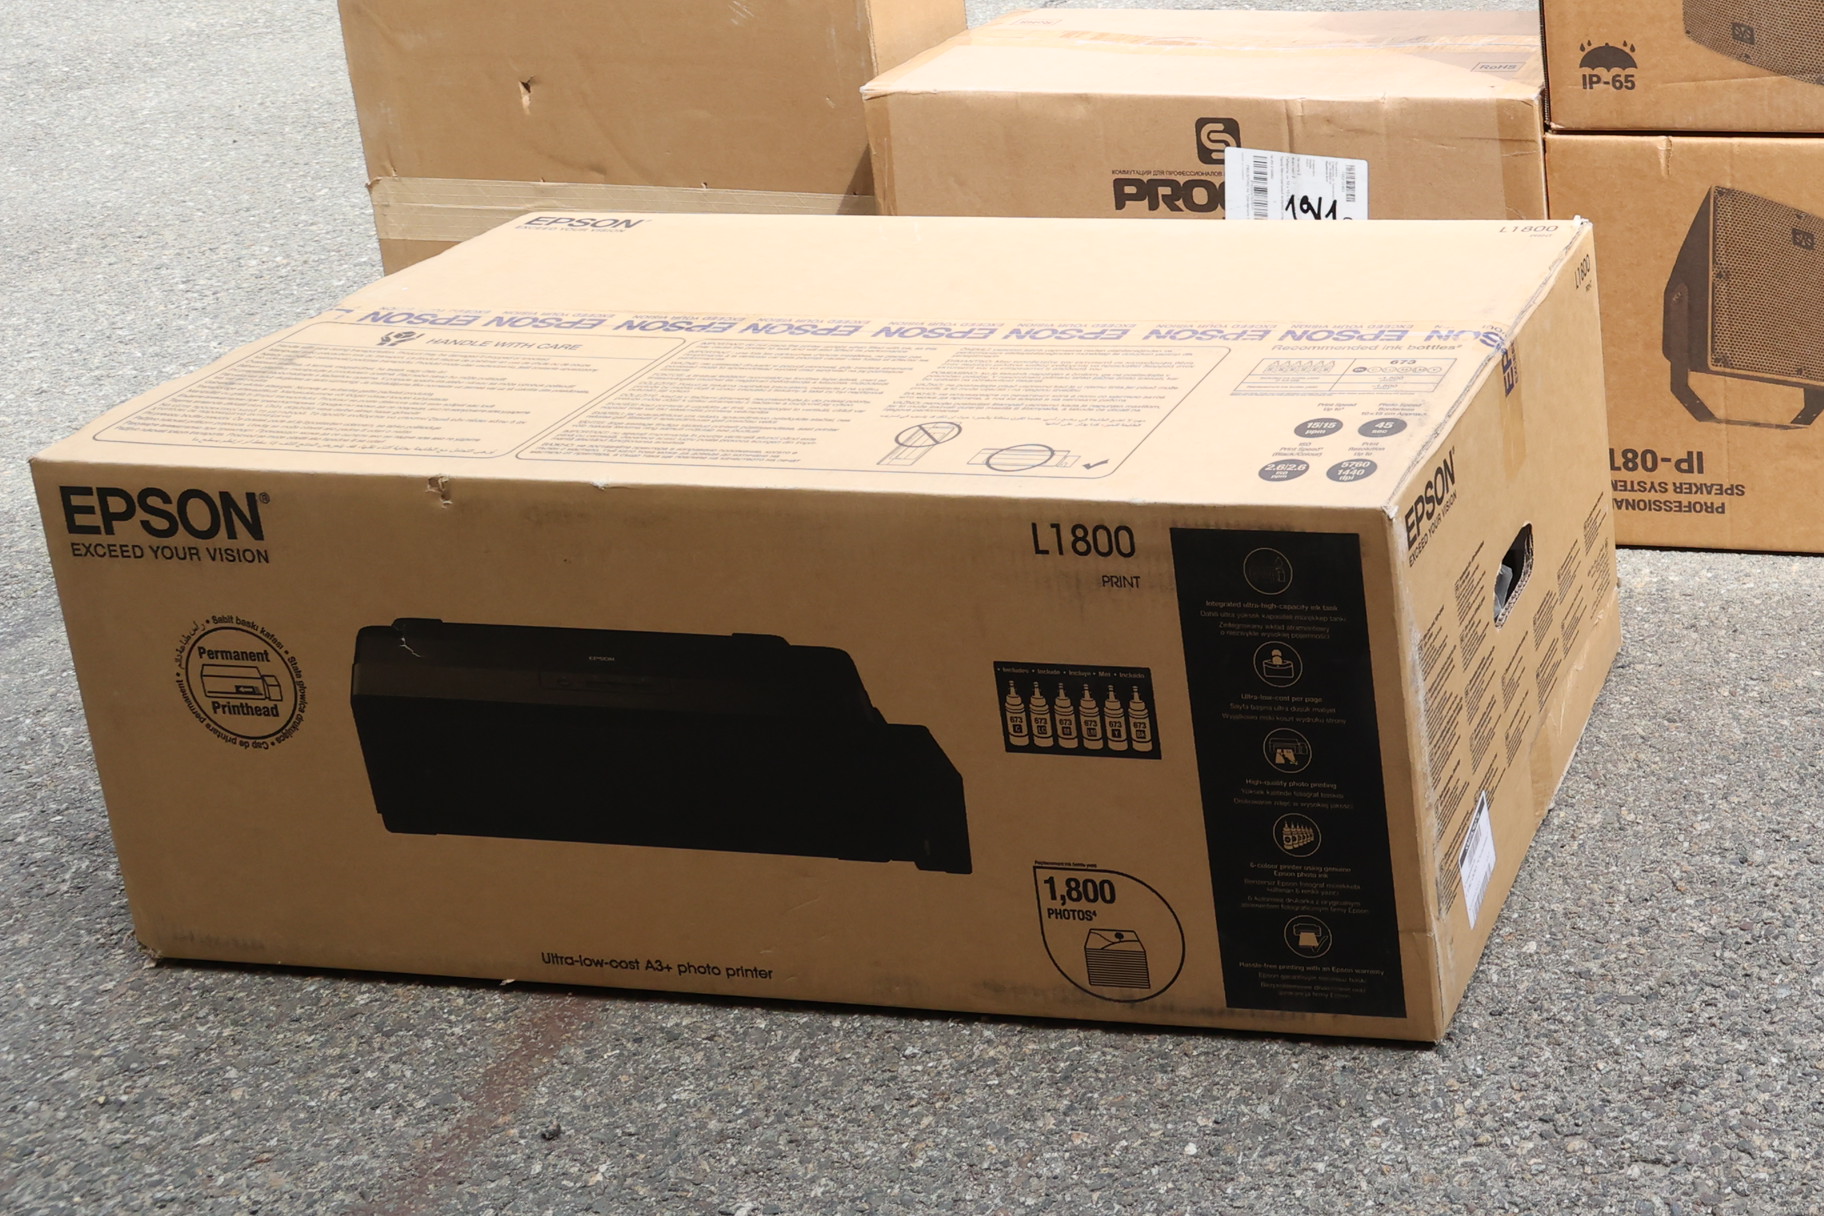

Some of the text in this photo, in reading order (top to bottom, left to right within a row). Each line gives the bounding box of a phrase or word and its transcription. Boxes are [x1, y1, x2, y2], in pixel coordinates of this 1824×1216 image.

[1582, 73, 1636, 92] IP-65
[1113, 178, 1225, 213] PRO
[524, 216, 645, 228] EPSON
[1499, 225, 1559, 233] L1800
[357, 311, 482, 326] EPSON
[482, 315, 607, 330] EPSON
[613, 319, 738, 333] EPSON
[738, 323, 864, 336] EPSON
[871, 326, 997, 340] EPSON
[1002, 327, 1130, 341] EPSON
[1142, 329, 1272, 342] EPSON
[1278, 329, 1408, 342] EPSON
[426, 338, 583, 351] HANDLE WITH CARE
[1306, 422, 1337, 430] 15/15
[1375, 422, 1394, 430] 45
[1338, 468, 1365, 476] 1440
[1672, 482, 1745, 496] SPEAKER
[1405, 450, 1455, 551] EPSON
[1612, 498, 1725, 514] PROFESSIONA
[58, 485, 264, 541] EPSON
[1031, 522, 1136, 558] L1800
[71, 542, 269, 564] EXCEED YOUR VISION
[1101, 575, 1141, 588] PRINT
[198, 646, 270, 662] Permanent
[211, 701, 280, 717] Printhead
[1044, 876, 1116, 906] 1,800
[541, 952, 773, 980] Ultra-low-cost A3+ photo printer
